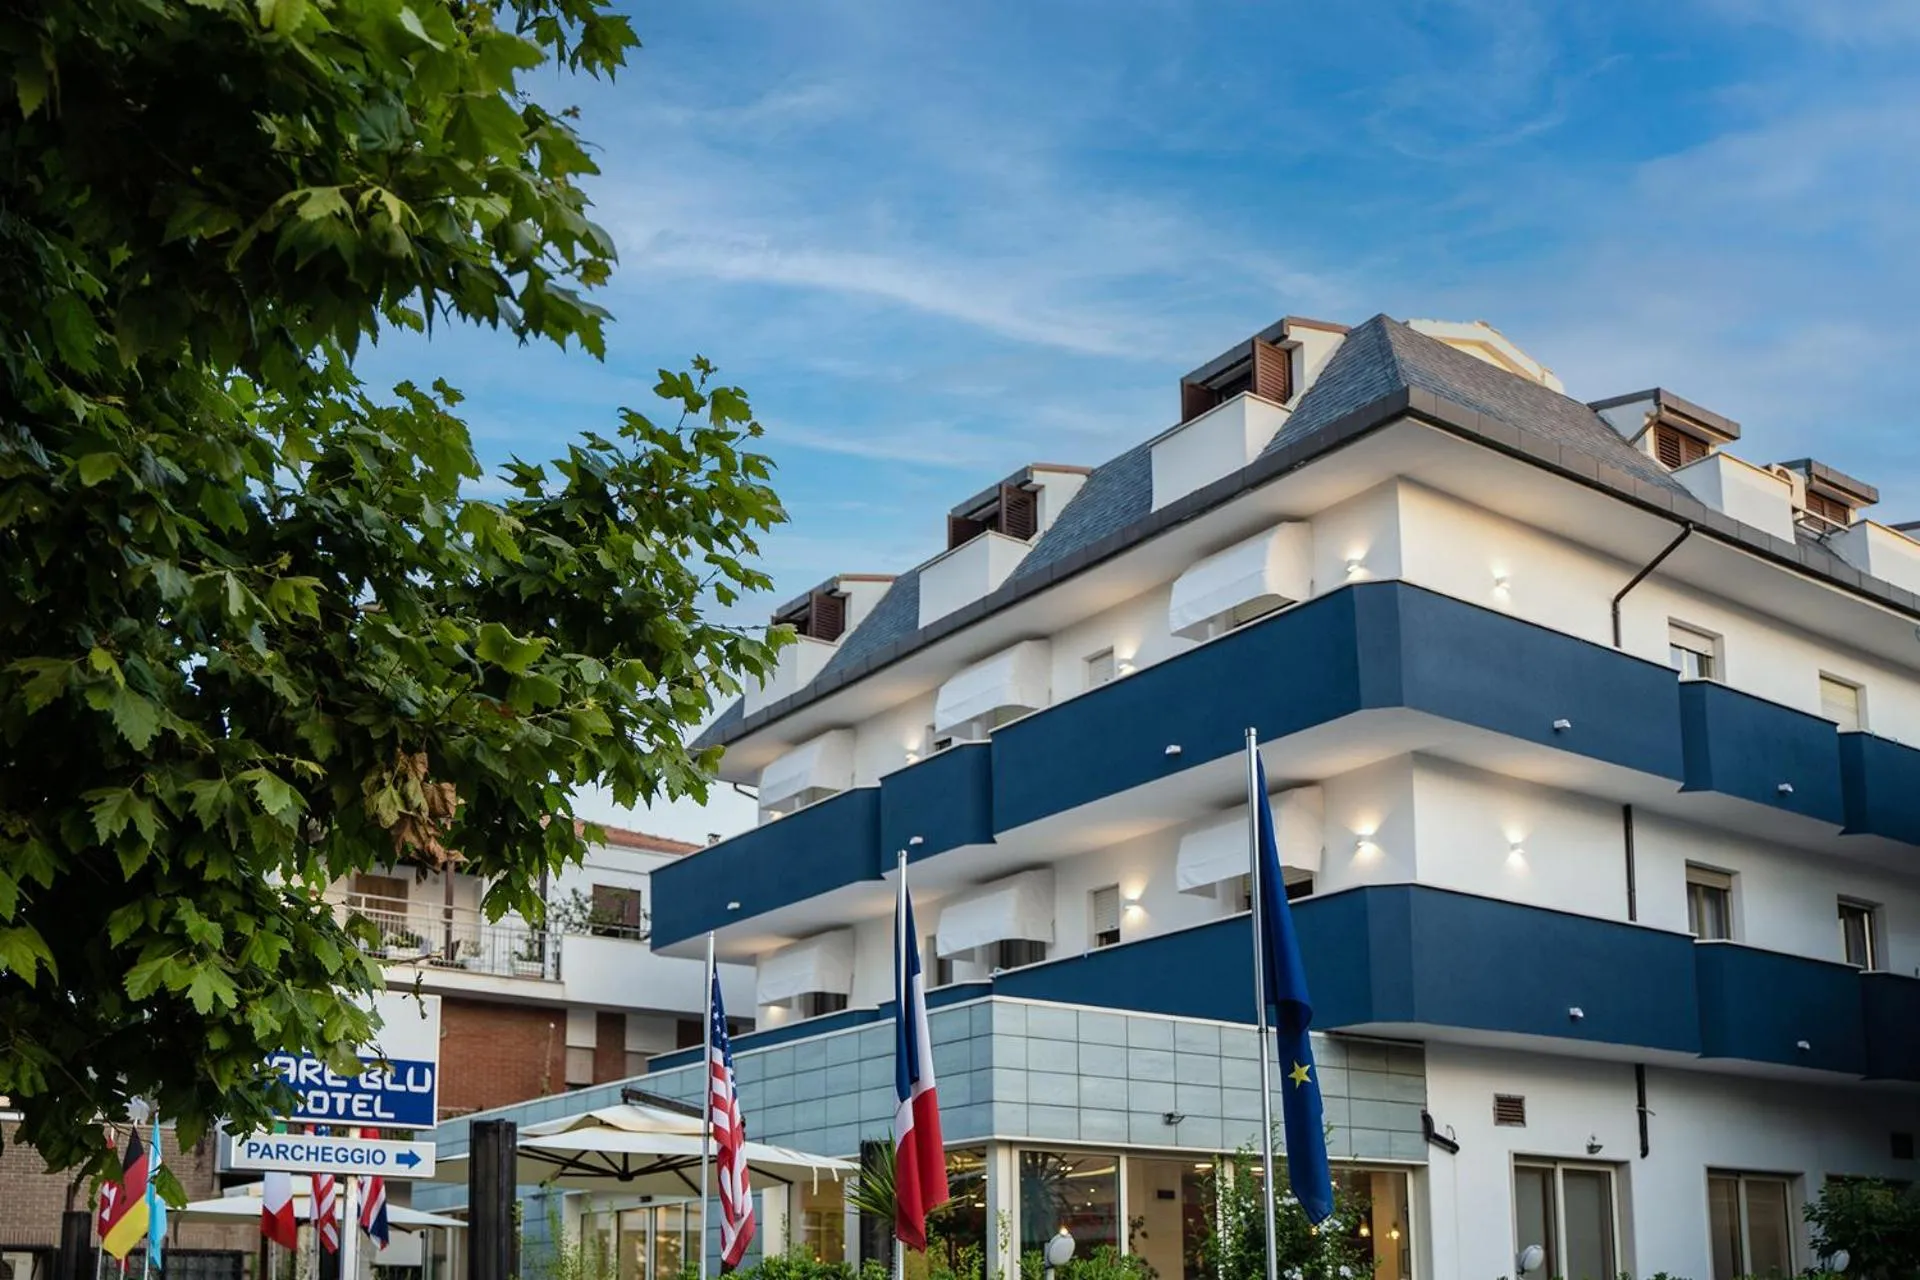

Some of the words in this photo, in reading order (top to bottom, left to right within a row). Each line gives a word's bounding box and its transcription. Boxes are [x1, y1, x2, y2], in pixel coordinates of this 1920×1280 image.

[253, 1056, 348, 1088] ARE
[358, 1063, 433, 1094] BLU
[246, 1142, 387, 1166] PARCHEGGIO
